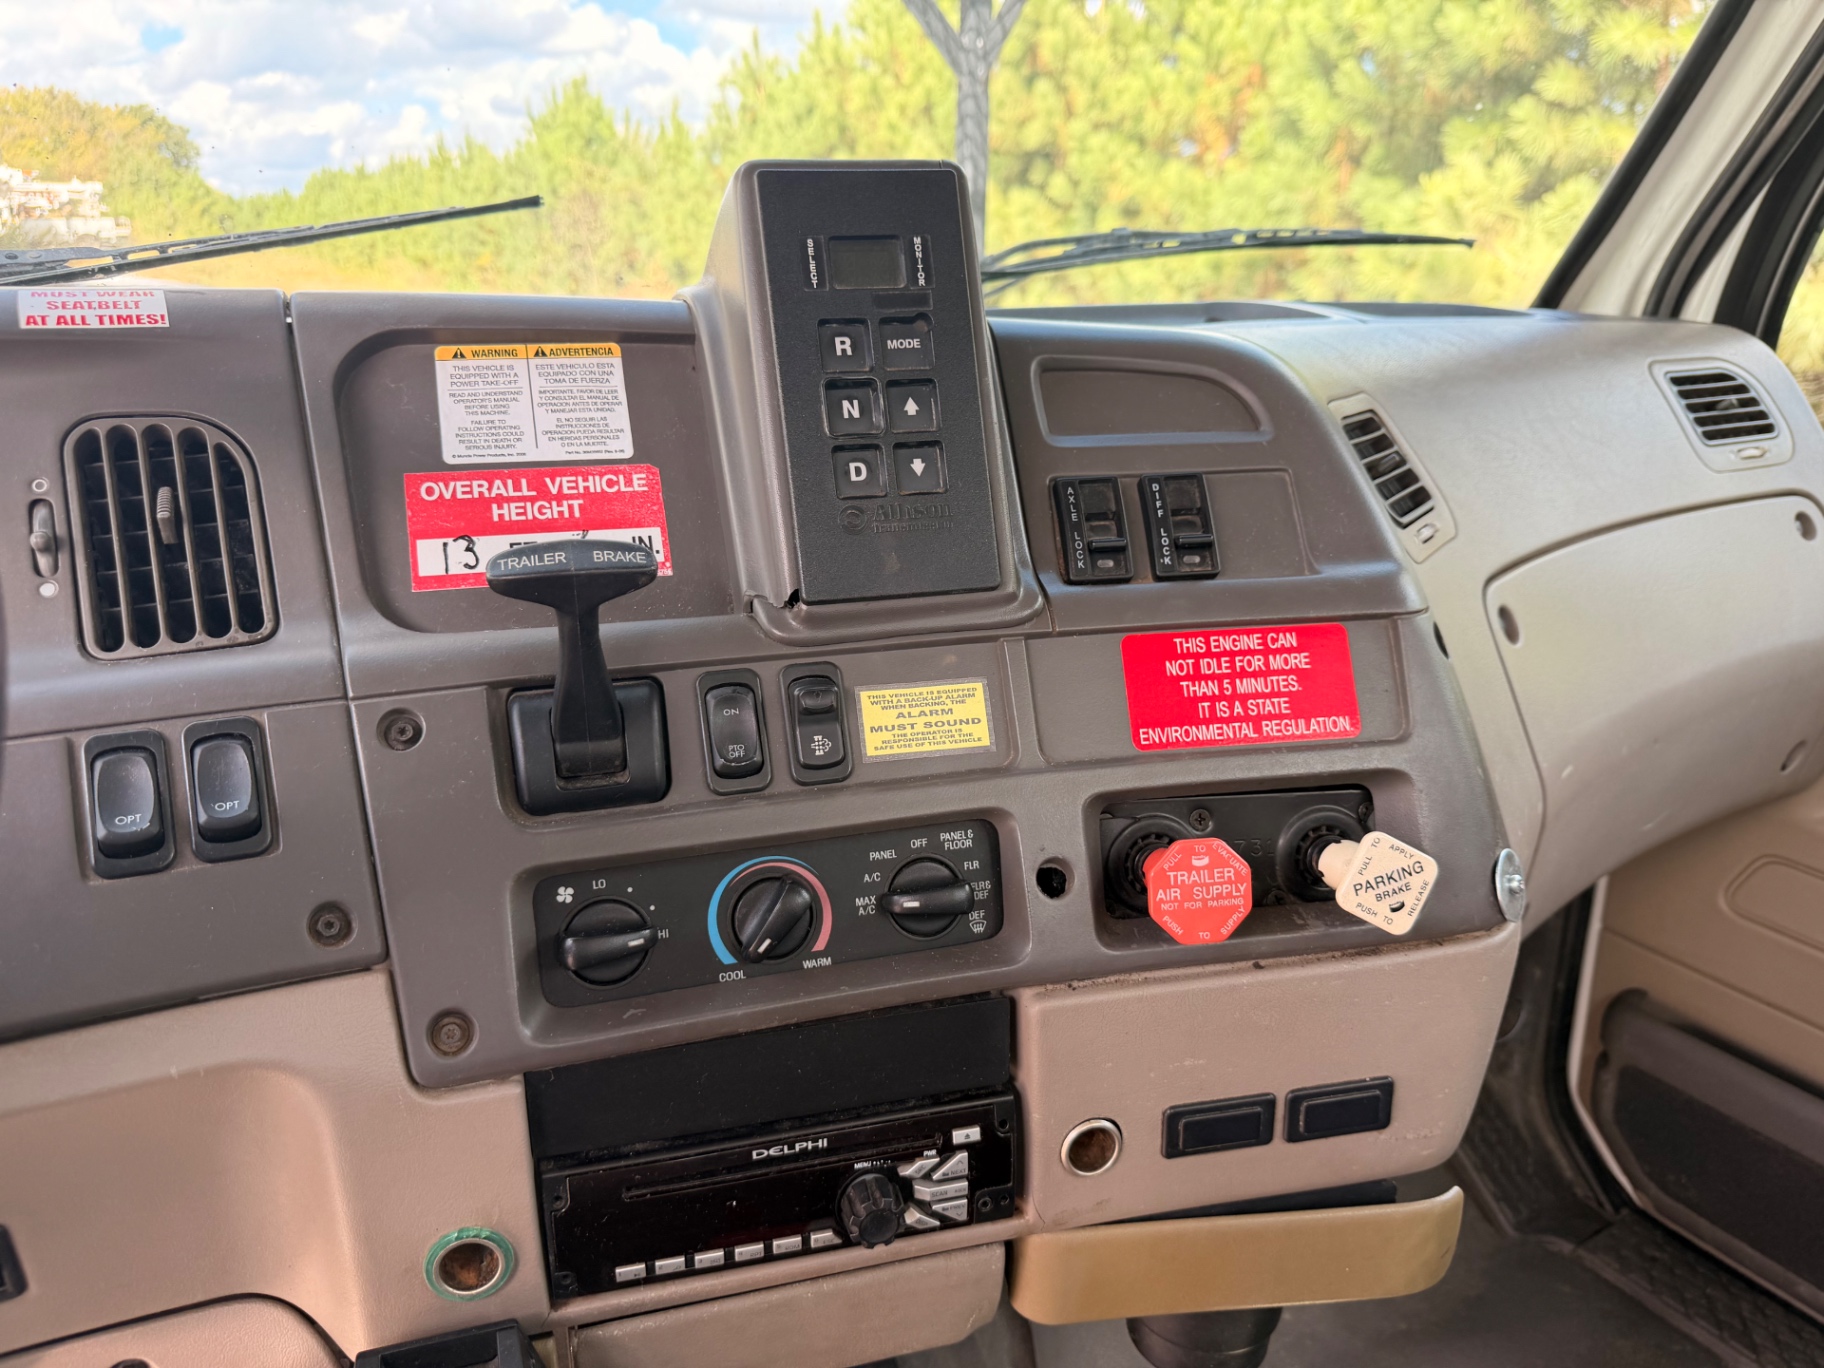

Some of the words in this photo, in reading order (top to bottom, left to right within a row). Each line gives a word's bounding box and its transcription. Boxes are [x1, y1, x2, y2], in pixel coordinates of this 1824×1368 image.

[806, 238, 818, 288] SELECT
[914, 236, 926, 286] MONITOR
[46, 300, 142, 310] SEATBELT
[25, 314, 50, 326] AT
[56, 314, 90, 326] ALL
[95, 314, 167, 326] TIMES!
[549, 348, 614, 356] ADVERTENCIA
[834, 336, 852, 356] R
[887, 339, 921, 350] MODE
[471, 350, 518, 358] WARNING
[842, 400, 860, 420] N
[849, 463, 868, 482] D
[420, 478, 537, 501] OVERALL
[544, 474, 649, 495] VEHICLE
[492, 500, 584, 522] HEIGHT
[1067, 486, 1078, 522] AXLE
[1074, 532, 1085, 568] LOCK
[1152, 484, 1164, 518] DIFF
[1160, 528, 1172, 565] LOCK
[442, 534, 480, 574] 13
[497, 552, 566, 571] TRAILER
[593, 550, 646, 564] BRAKE
[1173, 638, 1206, 654] THIS
[1210, 634, 1263, 652] ENGINE
[1267, 632, 1297, 648] CAN
[1166, 660, 1194, 676] NOT
[1200, 658, 1232, 674] IDLE
[1235, 655, 1266, 672] FOR
[1269, 653, 1311, 670] MORE
[1180, 680, 1219, 698] THAN
[1224, 680, 1232, 695] 5
[1236, 676, 1302, 694] MINUTES.
[896, 708, 954, 720] ALARM
[1198, 702, 1210, 718] IT
[1216, 702, 1230, 718] IS
[1234, 701, 1244, 716] A
[1248, 698, 1290, 716] STATE
[870, 722, 918, 734] MUST
[924, 718, 982, 729] SOUND
[1139, 722, 1258, 744] ENVIRONMENTAL
[1262, 716, 1354, 736] REGULATION.
[882, 736, 938, 744] RESPONSIBLE
[214, 800, 240, 811] OPT
[115, 813, 142, 825] OPT
[910, 838, 928, 848] OFF
[940, 830, 966, 842] PANEL
[968, 829, 974, 838] &
[944, 839, 972, 850] FLOOR
[870, 849, 897, 861] PANEL
[1163, 852, 1182, 870] PULL
[1212, 842, 1248, 876] EVACUATE
[1358, 856, 1372, 876] PULL
[1371, 838, 1380, 848] TO
[1389, 844, 1414, 860] APPLY
[964, 860, 980, 870] FLR
[592, 879, 606, 890] LO
[864, 872, 880, 882] A/C
[1166, 868, 1234, 886] TRAILER
[1353, 860, 1424, 896] PARKING
[974, 890, 988, 900] DEF
[1156, 888, 1180, 902] AIR
[1193, 882, 1246, 900] SUPPLY
[1375, 882, 1412, 902] BRAKE
[856, 896, 876, 906] MAX
[1208, 898, 1244, 908] PARKING
[1356, 902, 1378, 918] PUSH
[1382, 916, 1394, 925] TO
[1408, 880, 1430, 916] RELEASE
[858, 905, 876, 916] A/C
[969, 910, 985, 920] DEF
[1163, 916, 1184, 935] PUSH
[1220, 906, 1246, 934] SUPPLY
[658, 929, 669, 940] HI
[802, 956, 832, 970] WARM
[718, 969, 746, 982] COOL
[752, 1138, 828, 1160] DELPHI
[854, 1161, 872, 1169] MENU
